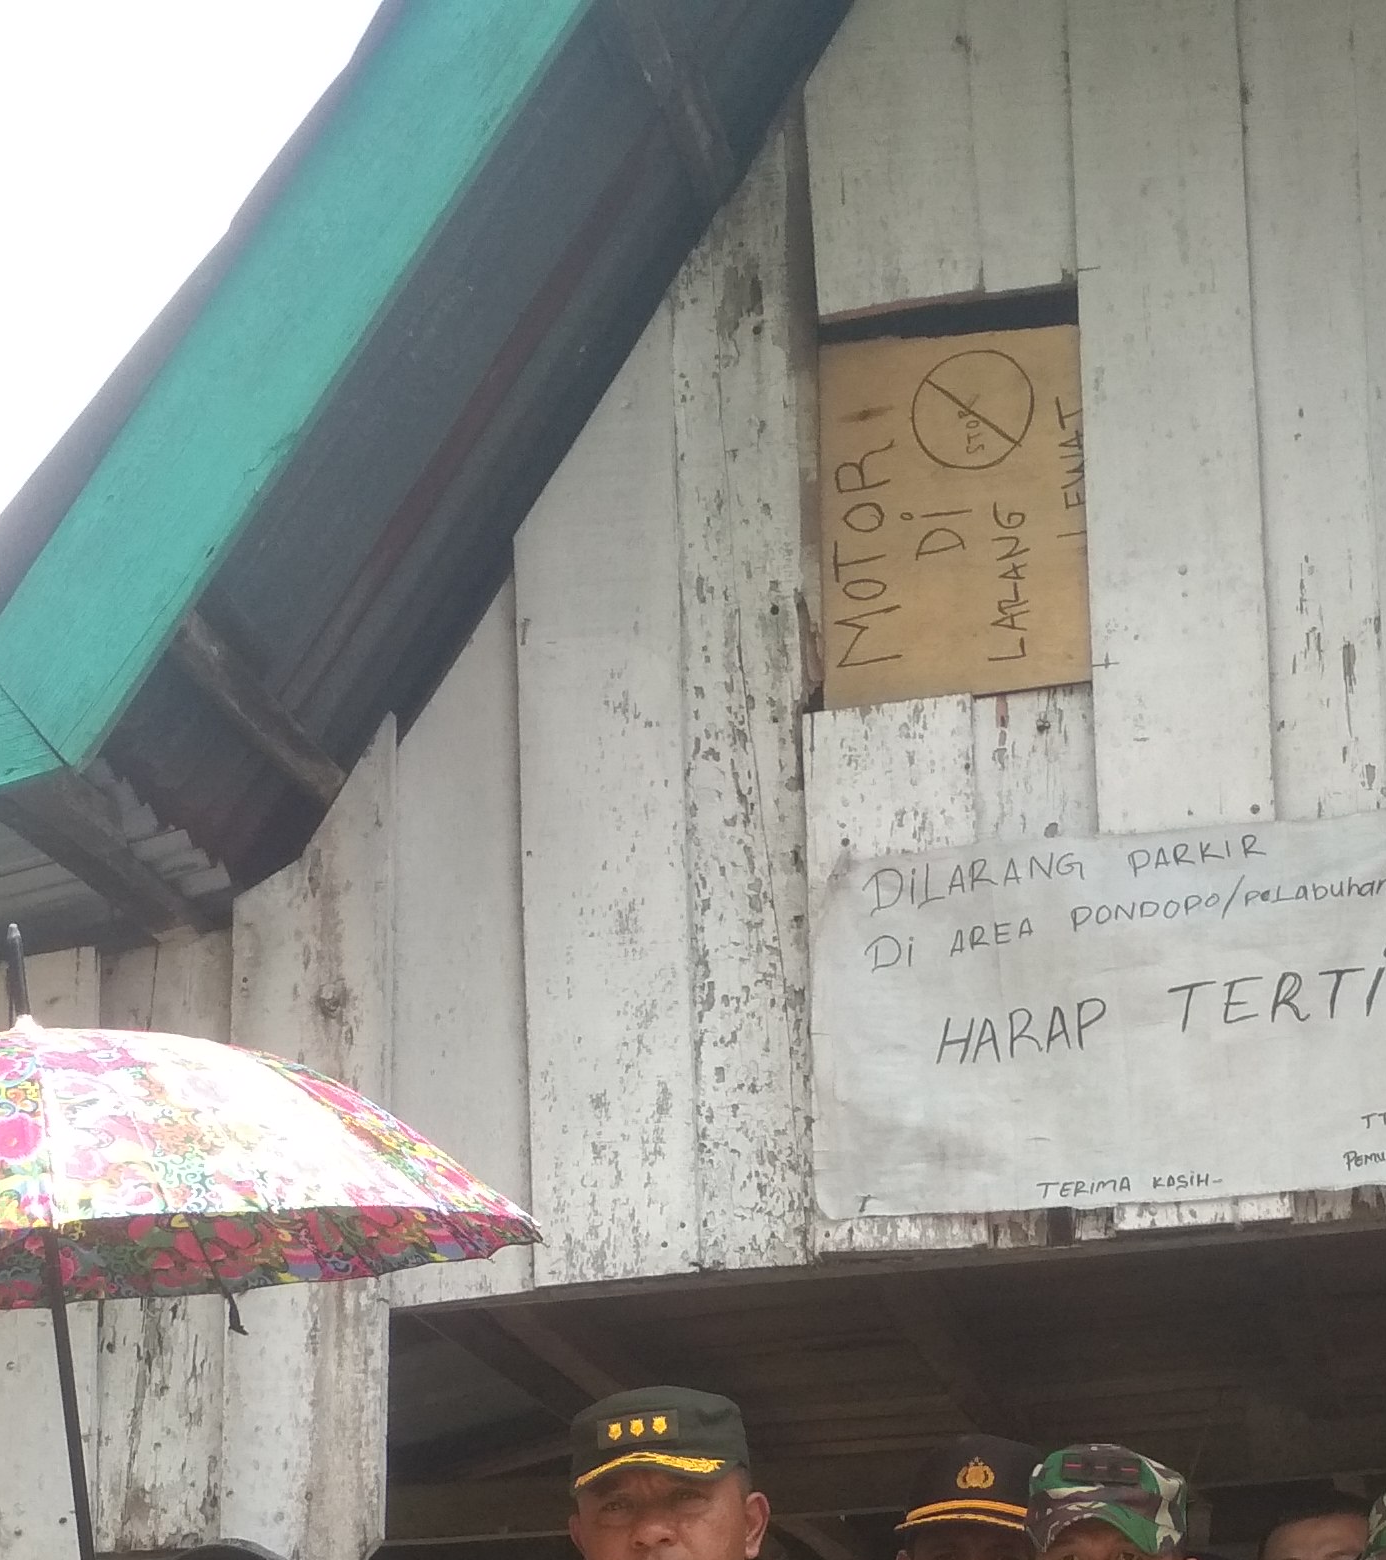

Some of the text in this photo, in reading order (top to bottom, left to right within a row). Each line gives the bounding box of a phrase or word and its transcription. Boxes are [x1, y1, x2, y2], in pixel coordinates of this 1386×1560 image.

[832, 438, 903, 667] MOTOR
[987, 500, 1032, 662] LARANG
[1127, 834, 1267, 878] PARKIR
[949, 916, 1034, 958] AREA
[935, 997, 1107, 1065] HARAP
